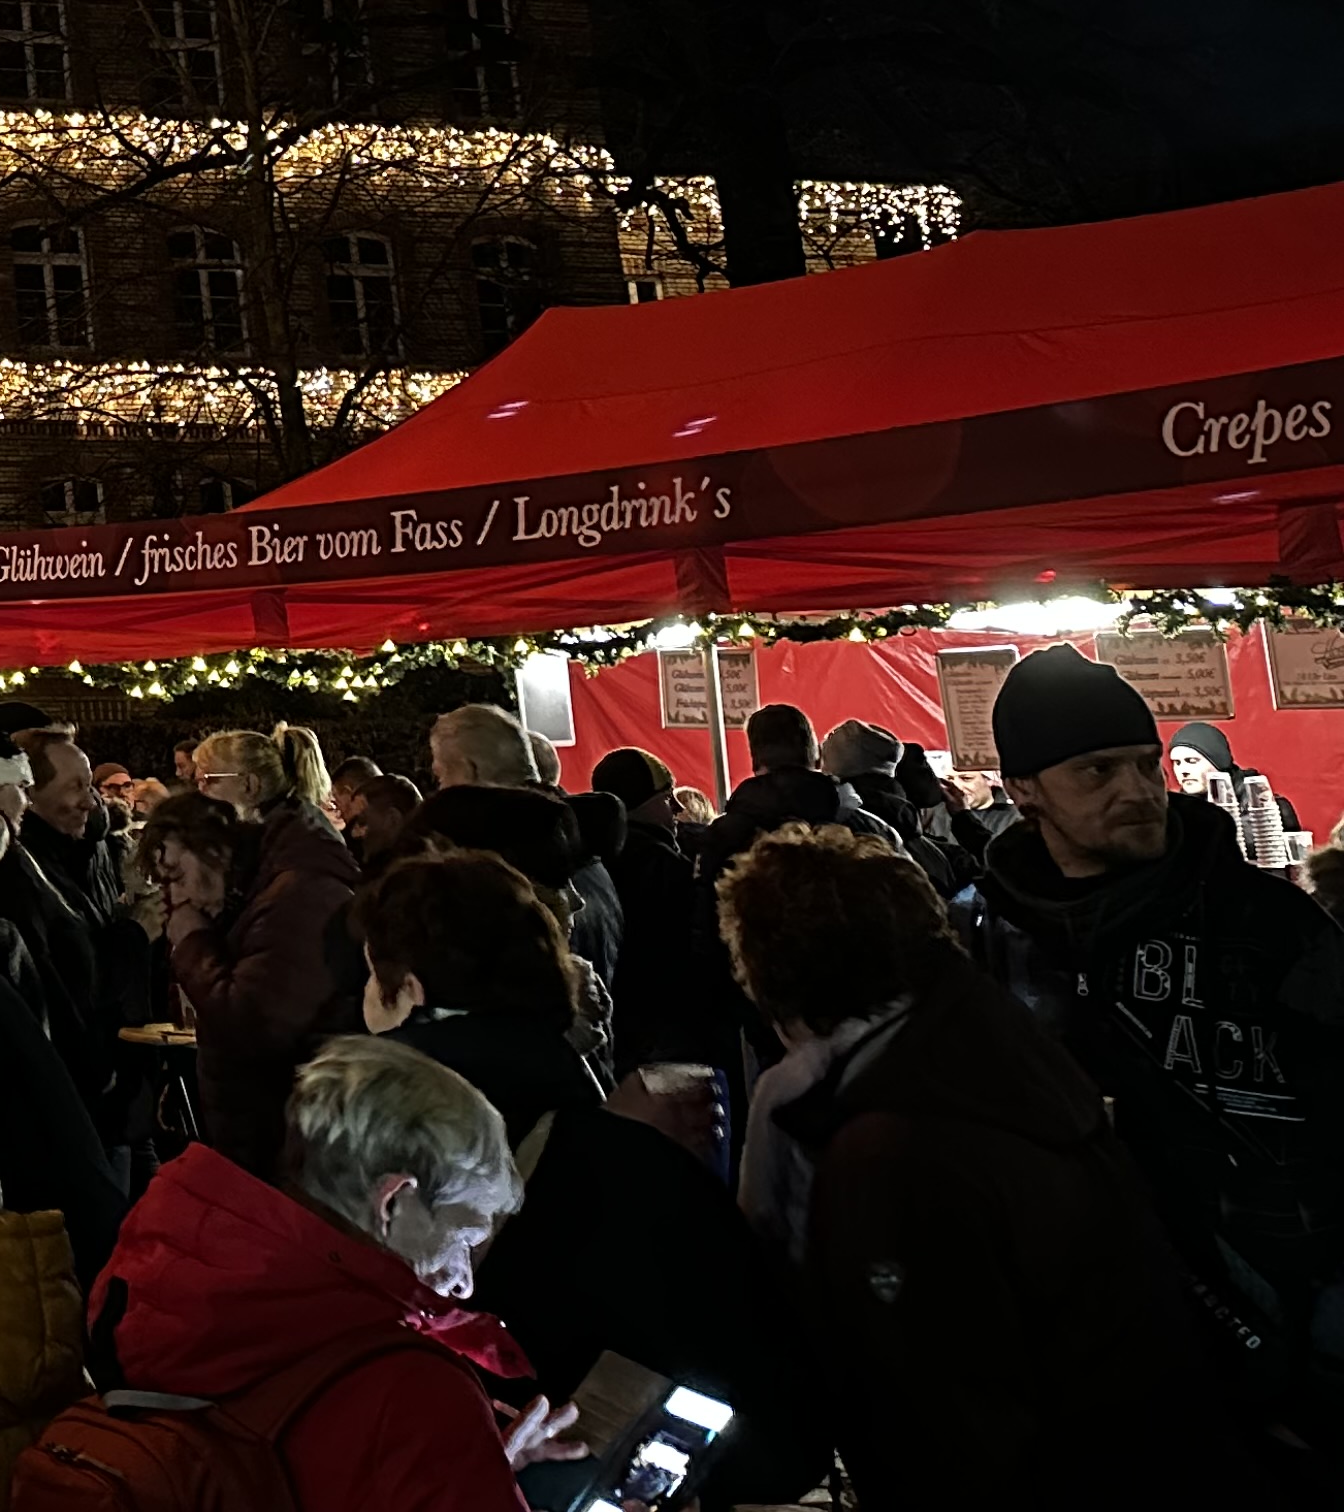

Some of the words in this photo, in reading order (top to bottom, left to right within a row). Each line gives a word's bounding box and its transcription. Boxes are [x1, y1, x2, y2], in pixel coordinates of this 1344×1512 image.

[1162, 399, 1332, 465] Crepes
[114, 537, 134, 576] /
[134, 531, 239, 586] frisches
[247, 523, 309, 567] Bier
[316, 527, 382, 560] vom
[390, 509, 463, 553] Fass
[477, 500, 500, 545] /
